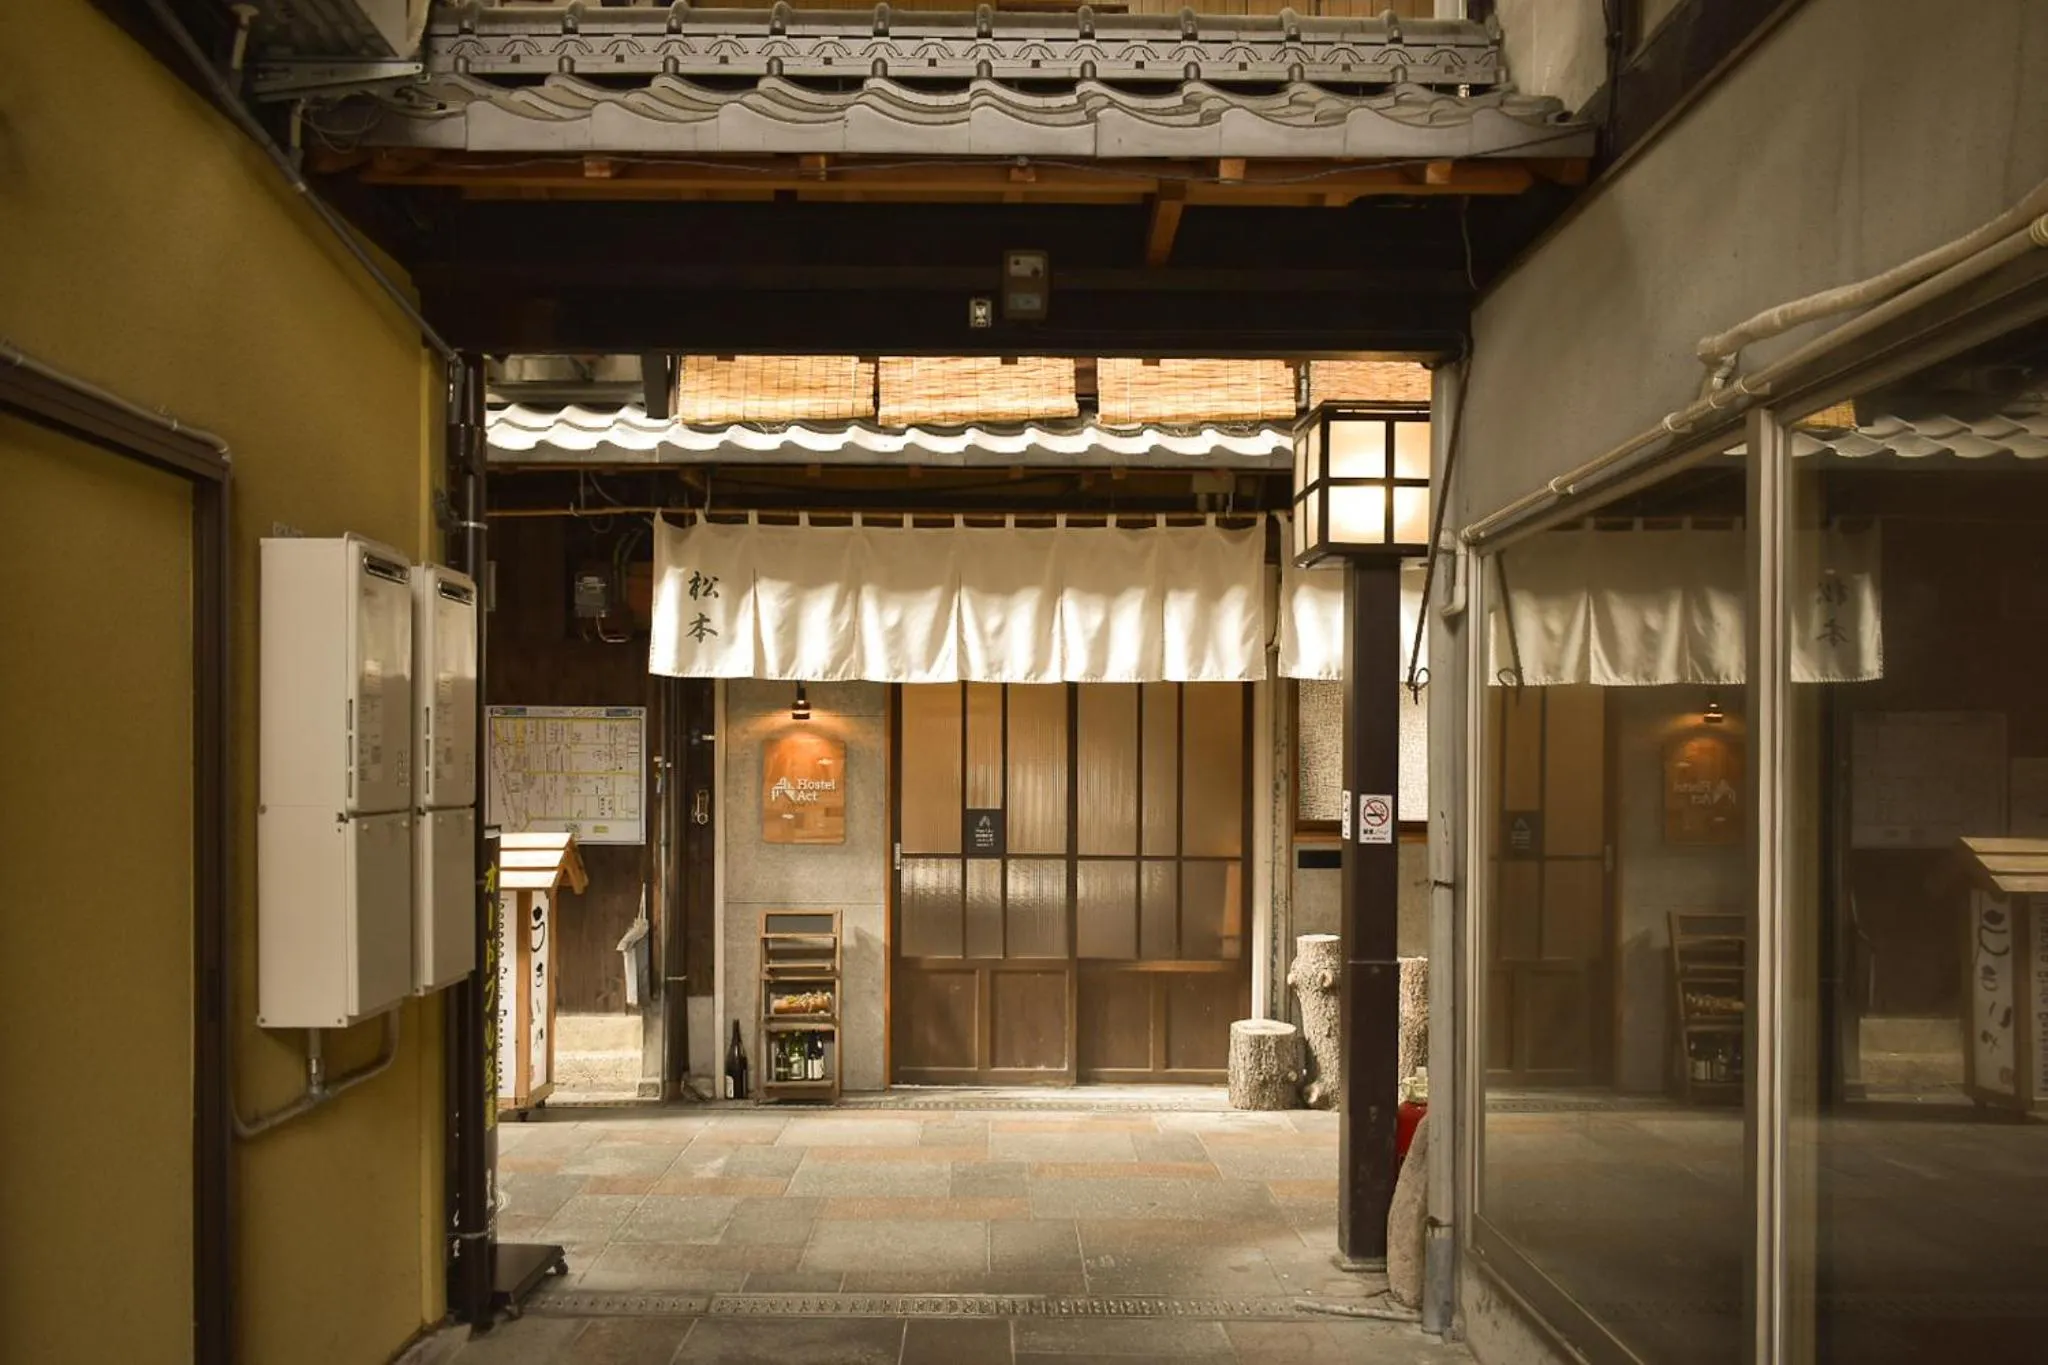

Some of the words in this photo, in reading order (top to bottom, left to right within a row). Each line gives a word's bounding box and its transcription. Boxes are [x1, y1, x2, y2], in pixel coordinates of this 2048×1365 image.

[686, 571, 719, 643] 松本
[797, 778, 835, 790] Hostel
[797, 790, 817, 801] Act
